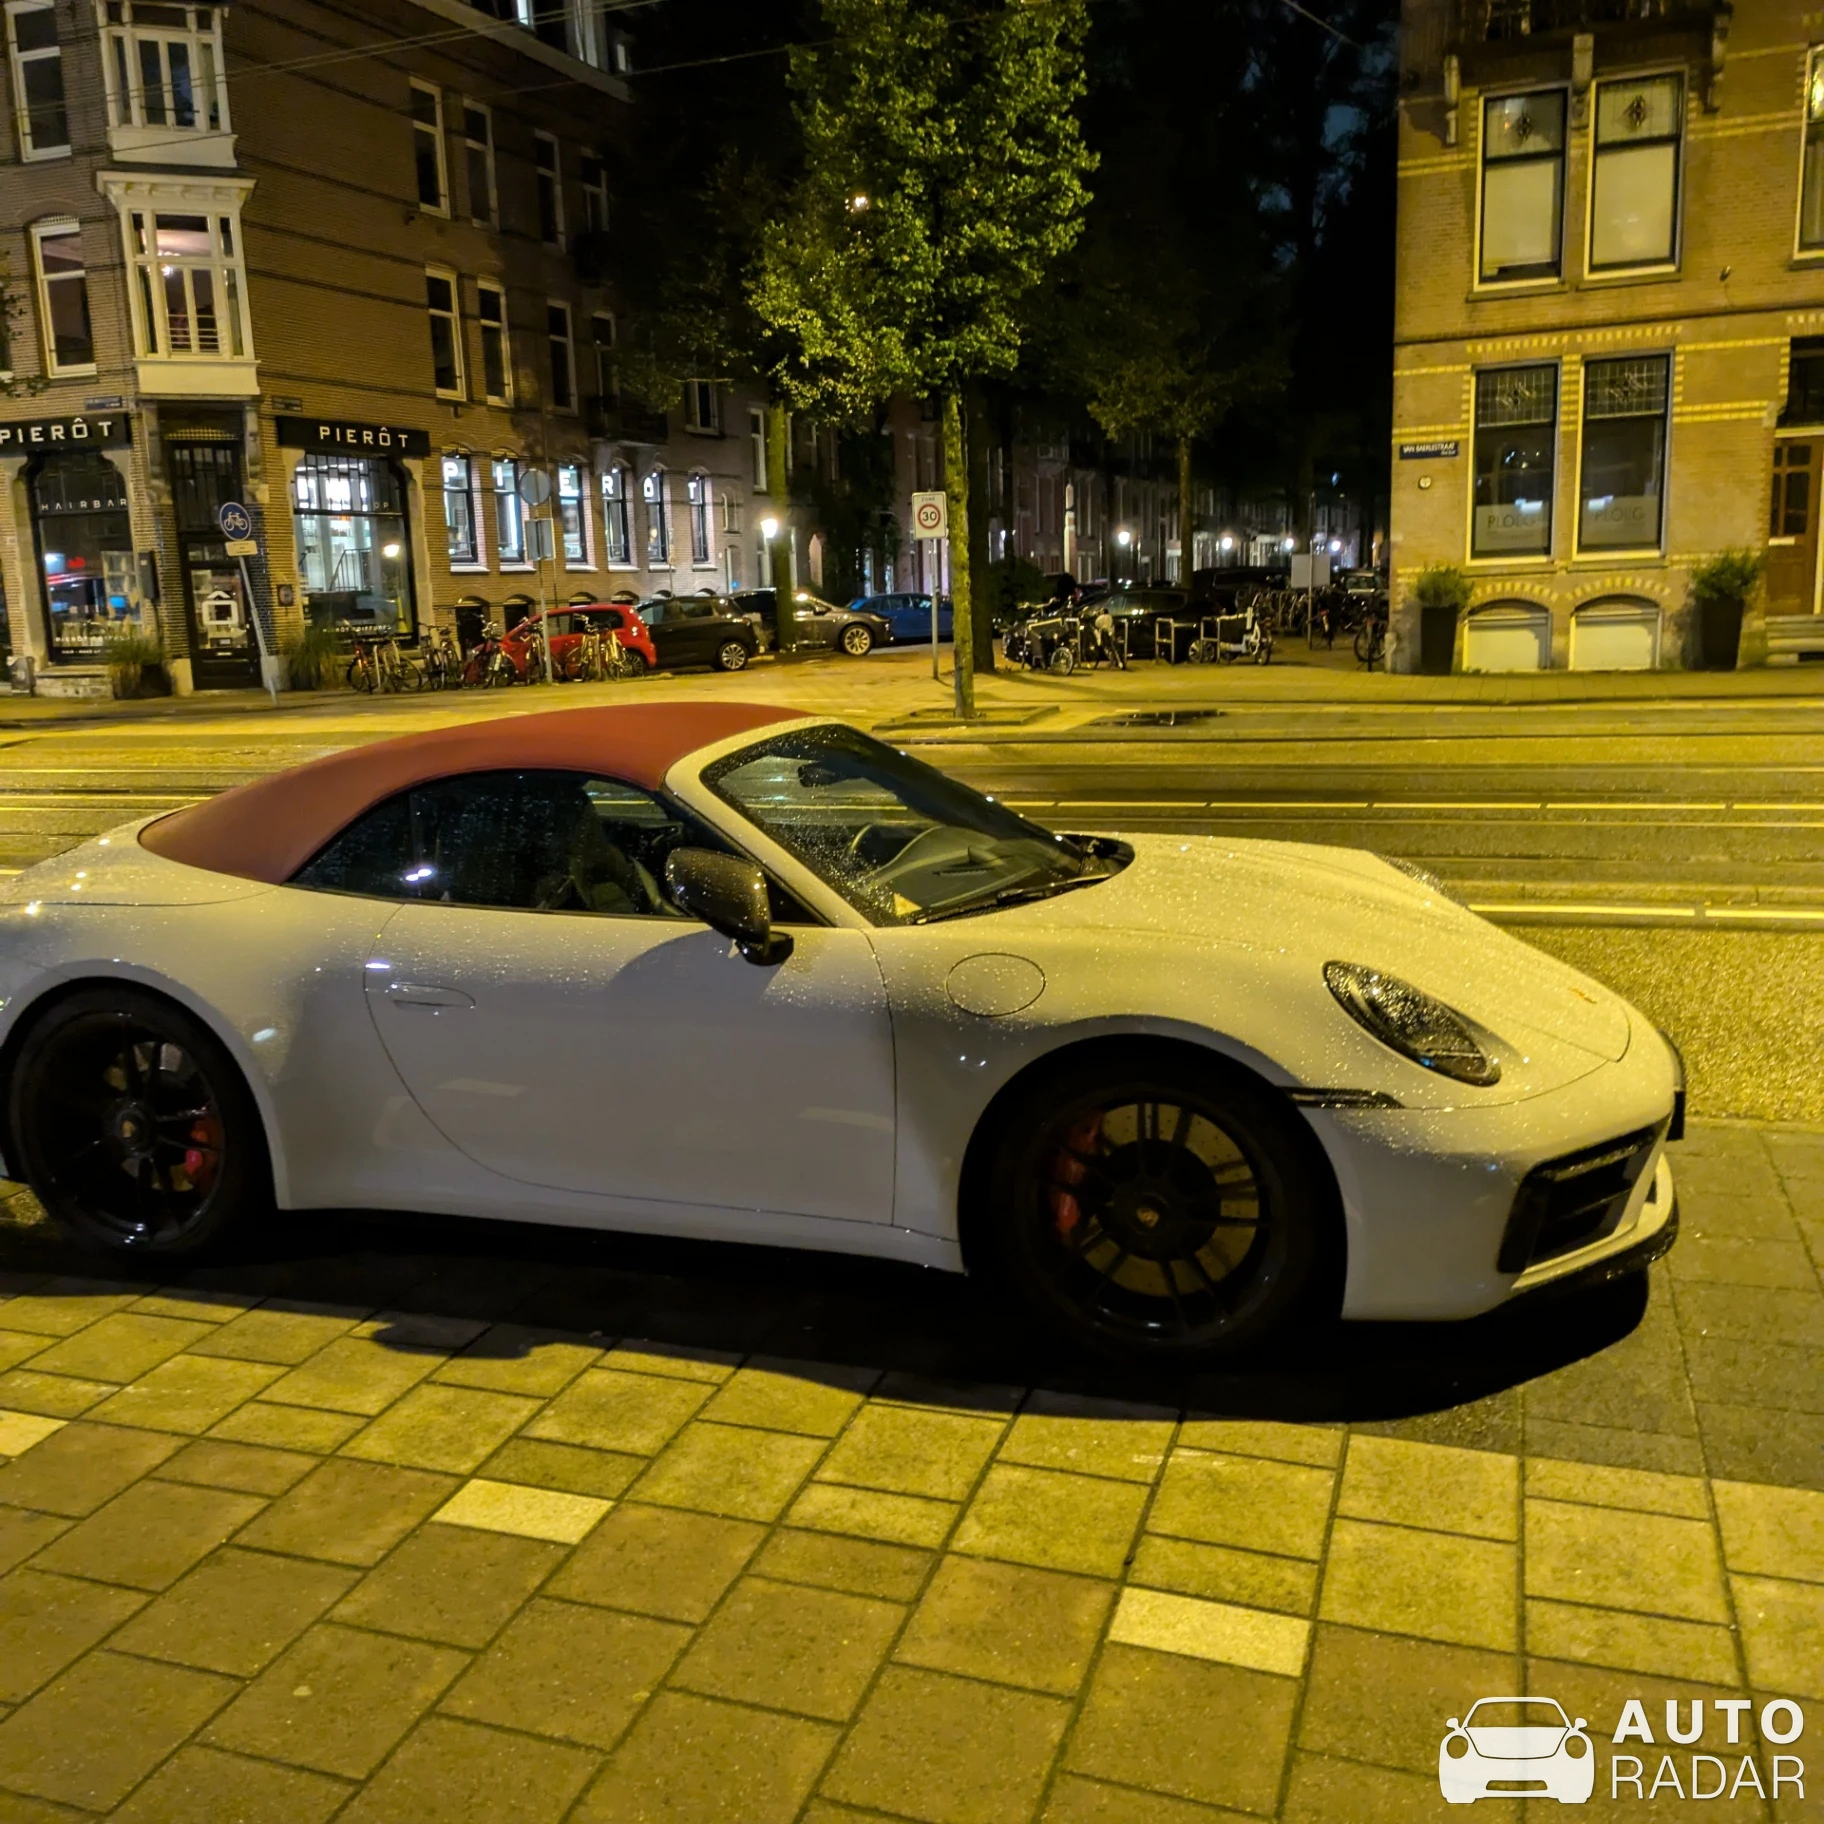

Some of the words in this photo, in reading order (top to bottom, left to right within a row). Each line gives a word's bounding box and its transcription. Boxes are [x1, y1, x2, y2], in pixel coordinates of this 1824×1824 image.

[0, 418, 112, 444] PIERÔT
[319, 427, 408, 448] PIERÔT
[922, 511, 937, 522] 30
